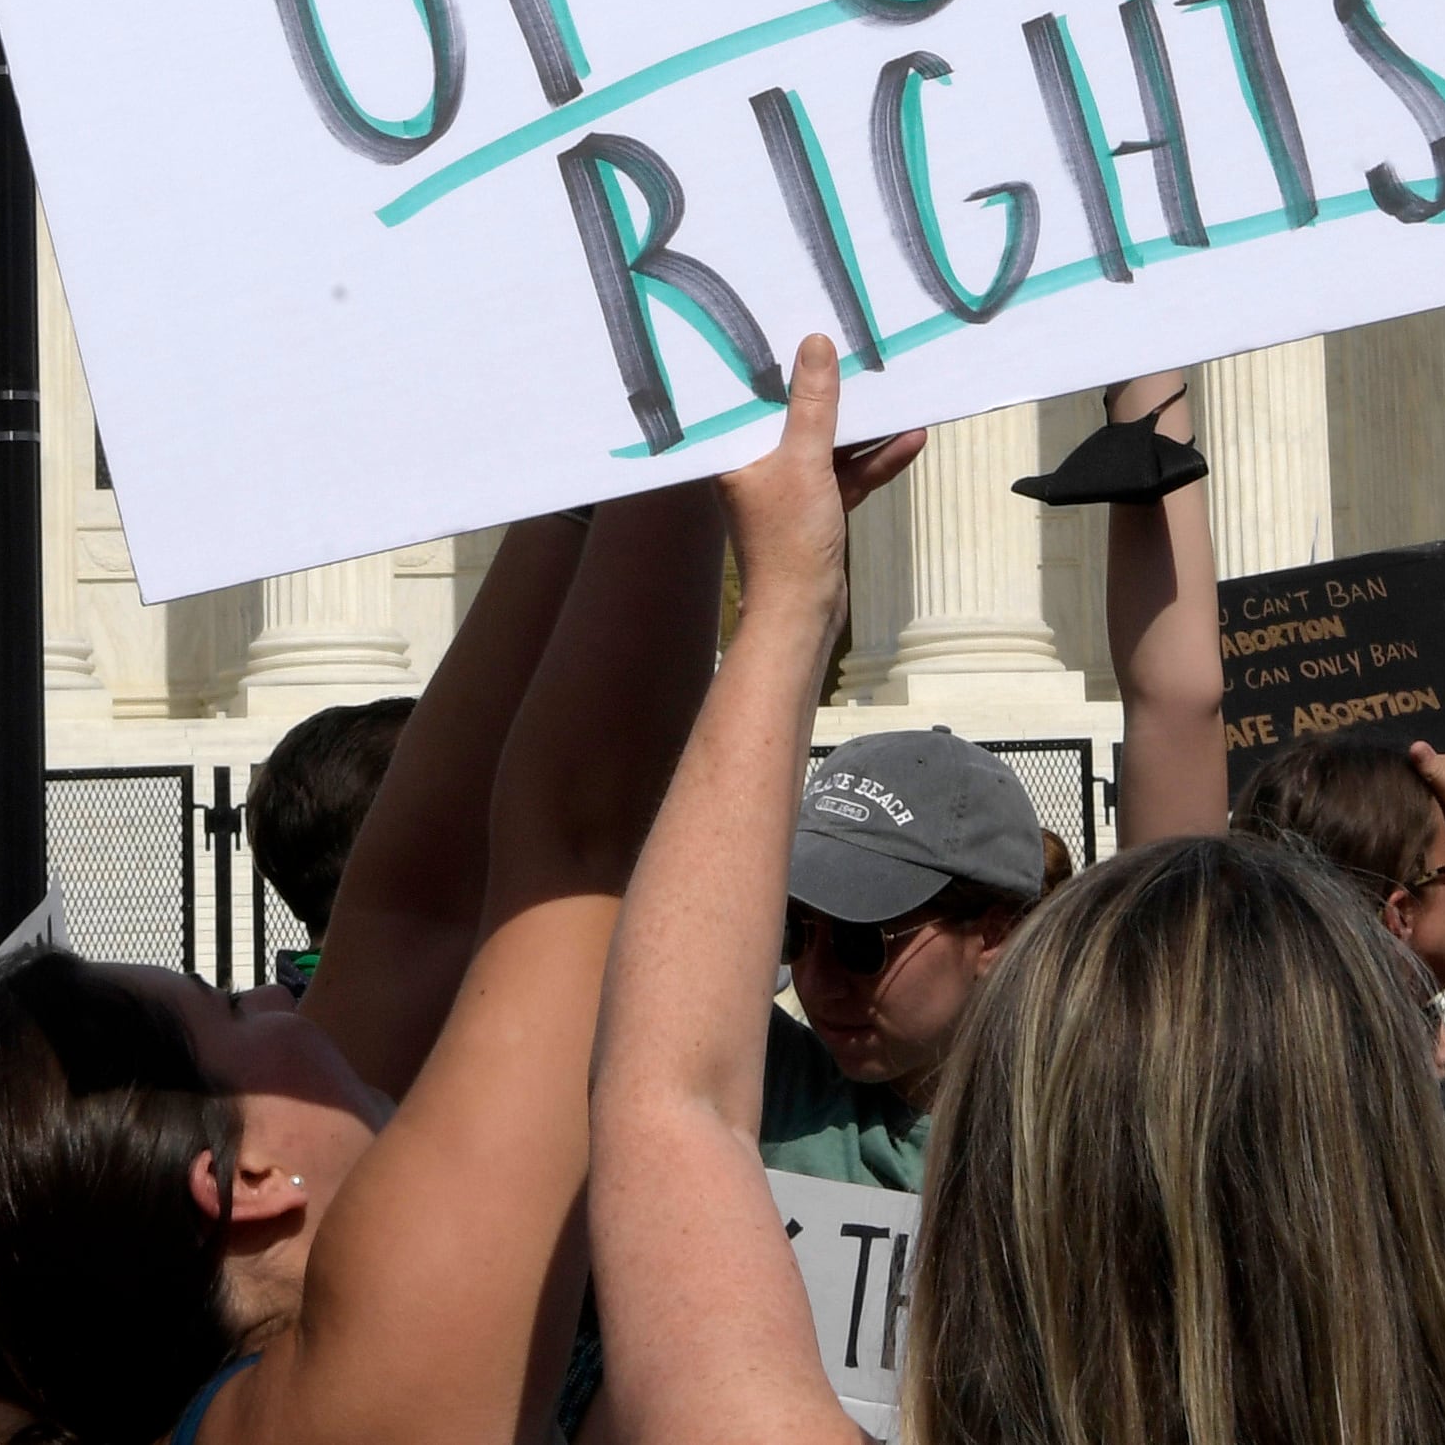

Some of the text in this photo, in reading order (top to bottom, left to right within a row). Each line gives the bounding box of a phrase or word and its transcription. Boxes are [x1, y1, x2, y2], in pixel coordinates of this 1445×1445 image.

[1242, 590, 1310, 621] CAN'T
[1325, 576, 1388, 608] BAN
[1220, 614, 1346, 659] ABORTION
[1245, 666, 1290, 689] CAN
[1300, 650, 1362, 678] ONLY
[1369, 640, 1419, 668] BAN
[1226, 687, 1442, 752] AFE ABORTION
[855, 777, 915, 827] BEACH
